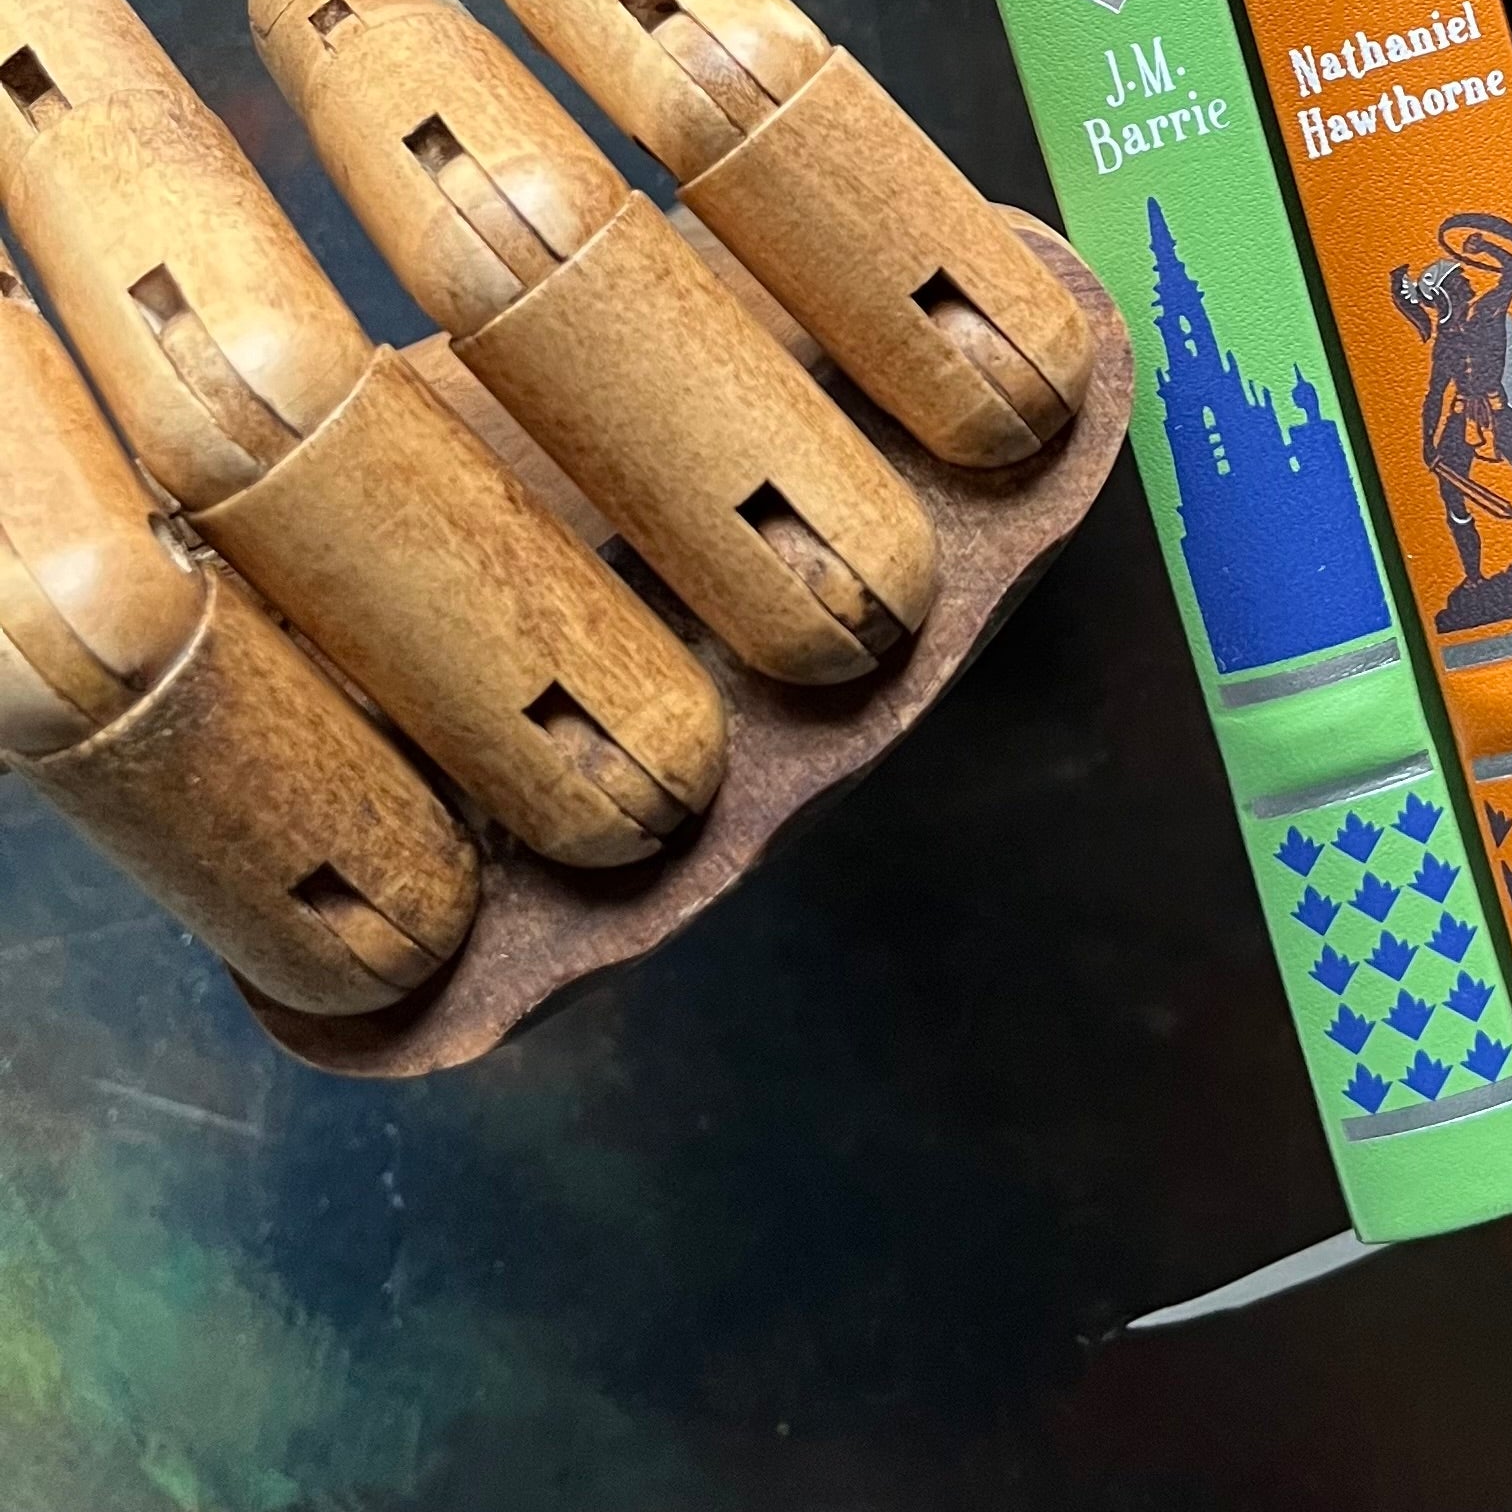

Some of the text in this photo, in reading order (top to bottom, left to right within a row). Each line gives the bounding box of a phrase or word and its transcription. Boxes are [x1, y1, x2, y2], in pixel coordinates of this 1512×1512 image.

[1103, 36, 1188, 108] J.M.
[1288, 0, 1482, 98] Nathaniel
[1082, 90, 1231, 175] Barrie
[1296, 69, 1507, 160] Hawthorne
